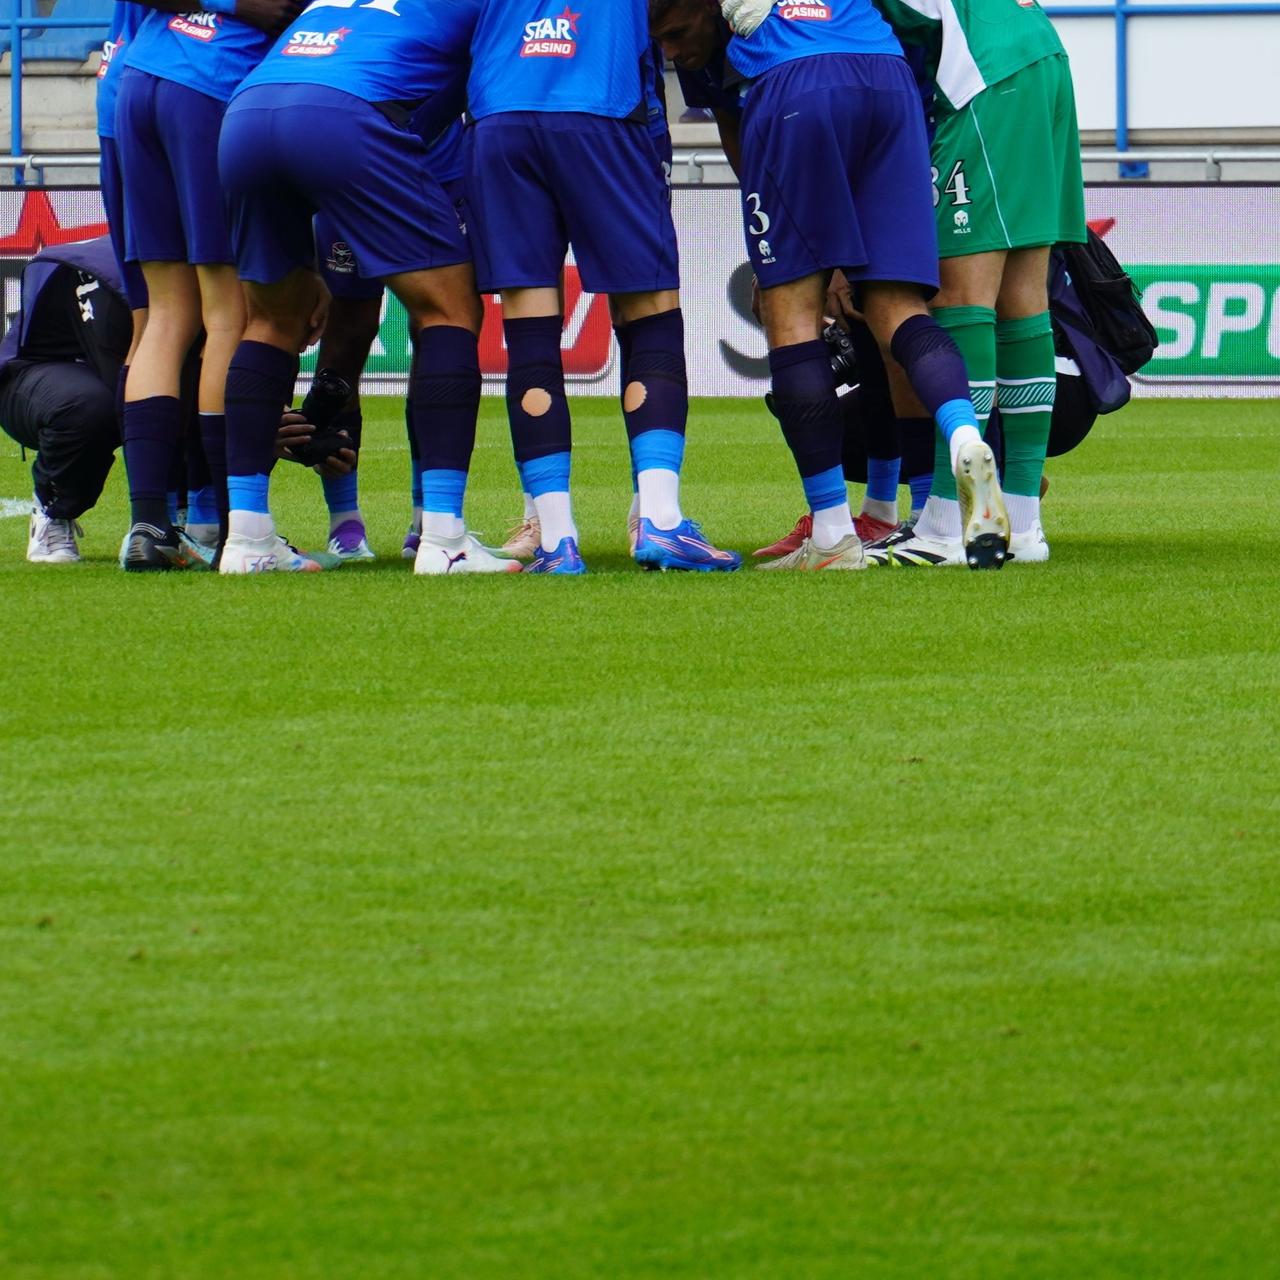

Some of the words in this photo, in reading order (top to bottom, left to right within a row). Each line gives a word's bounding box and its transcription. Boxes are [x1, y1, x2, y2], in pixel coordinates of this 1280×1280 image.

[783, 7, 828, 19] CASINO
[522, 17, 573, 42] STAR
[289, 30, 340, 46] STAR
[287, 45, 332, 55] CASINO
[524, 42, 572, 55] CASINO
[746, 192, 771, 235] 3
